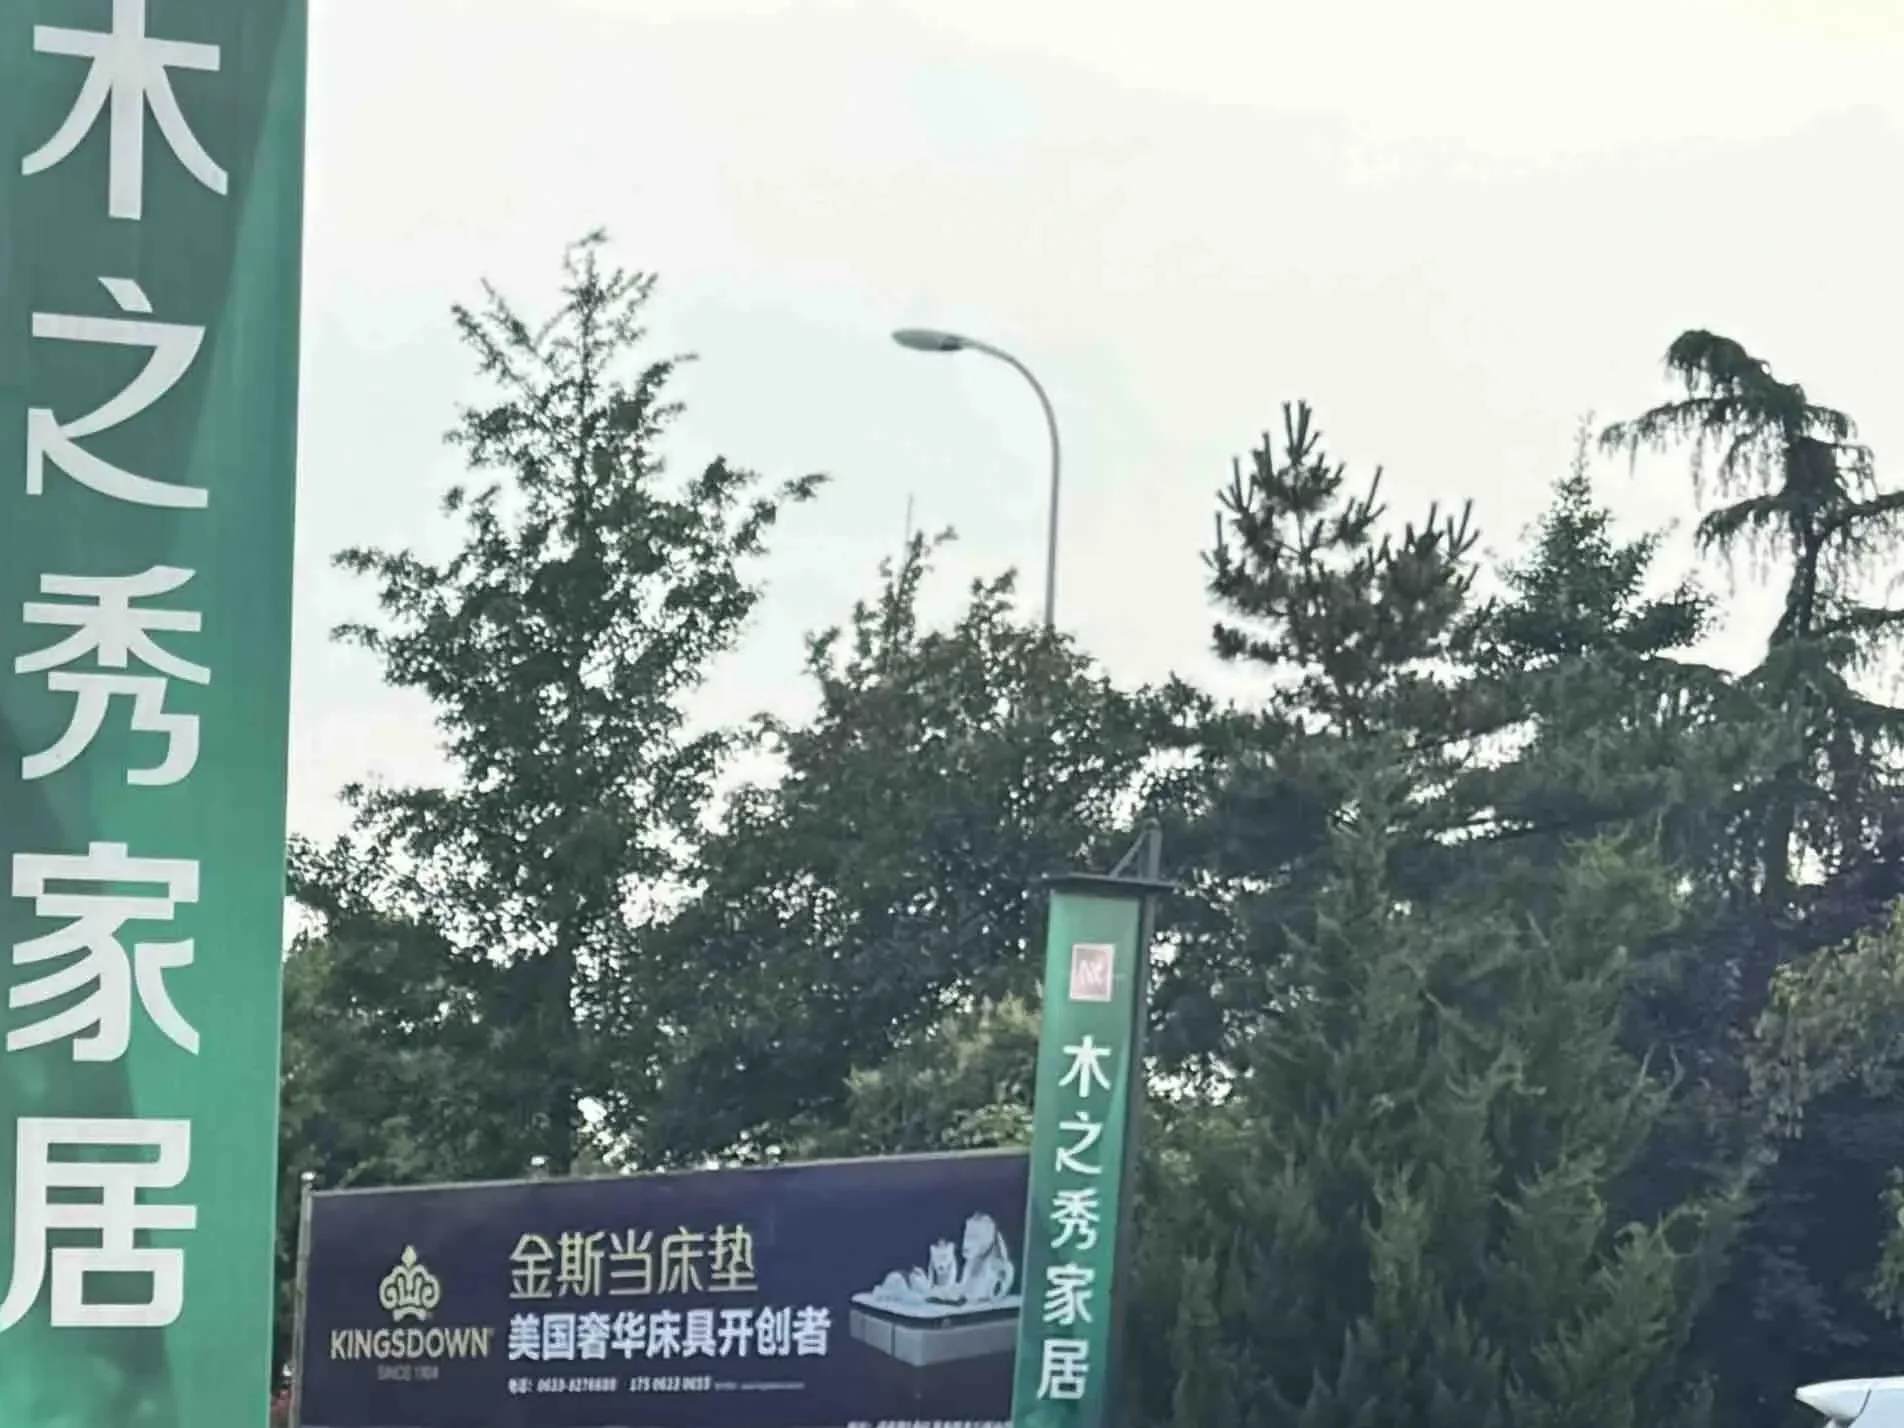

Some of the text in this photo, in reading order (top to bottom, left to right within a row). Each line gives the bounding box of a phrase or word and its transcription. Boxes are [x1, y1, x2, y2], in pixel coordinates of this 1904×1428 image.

[1037, 1034, 1112, 1400] 木之秀家居
[508, 1223, 759, 1299] 金斯当床垫
[330, 1327, 489, 1360] KINGSDOWN
[508, 1305, 832, 1361] 美国奢华床具开创者
